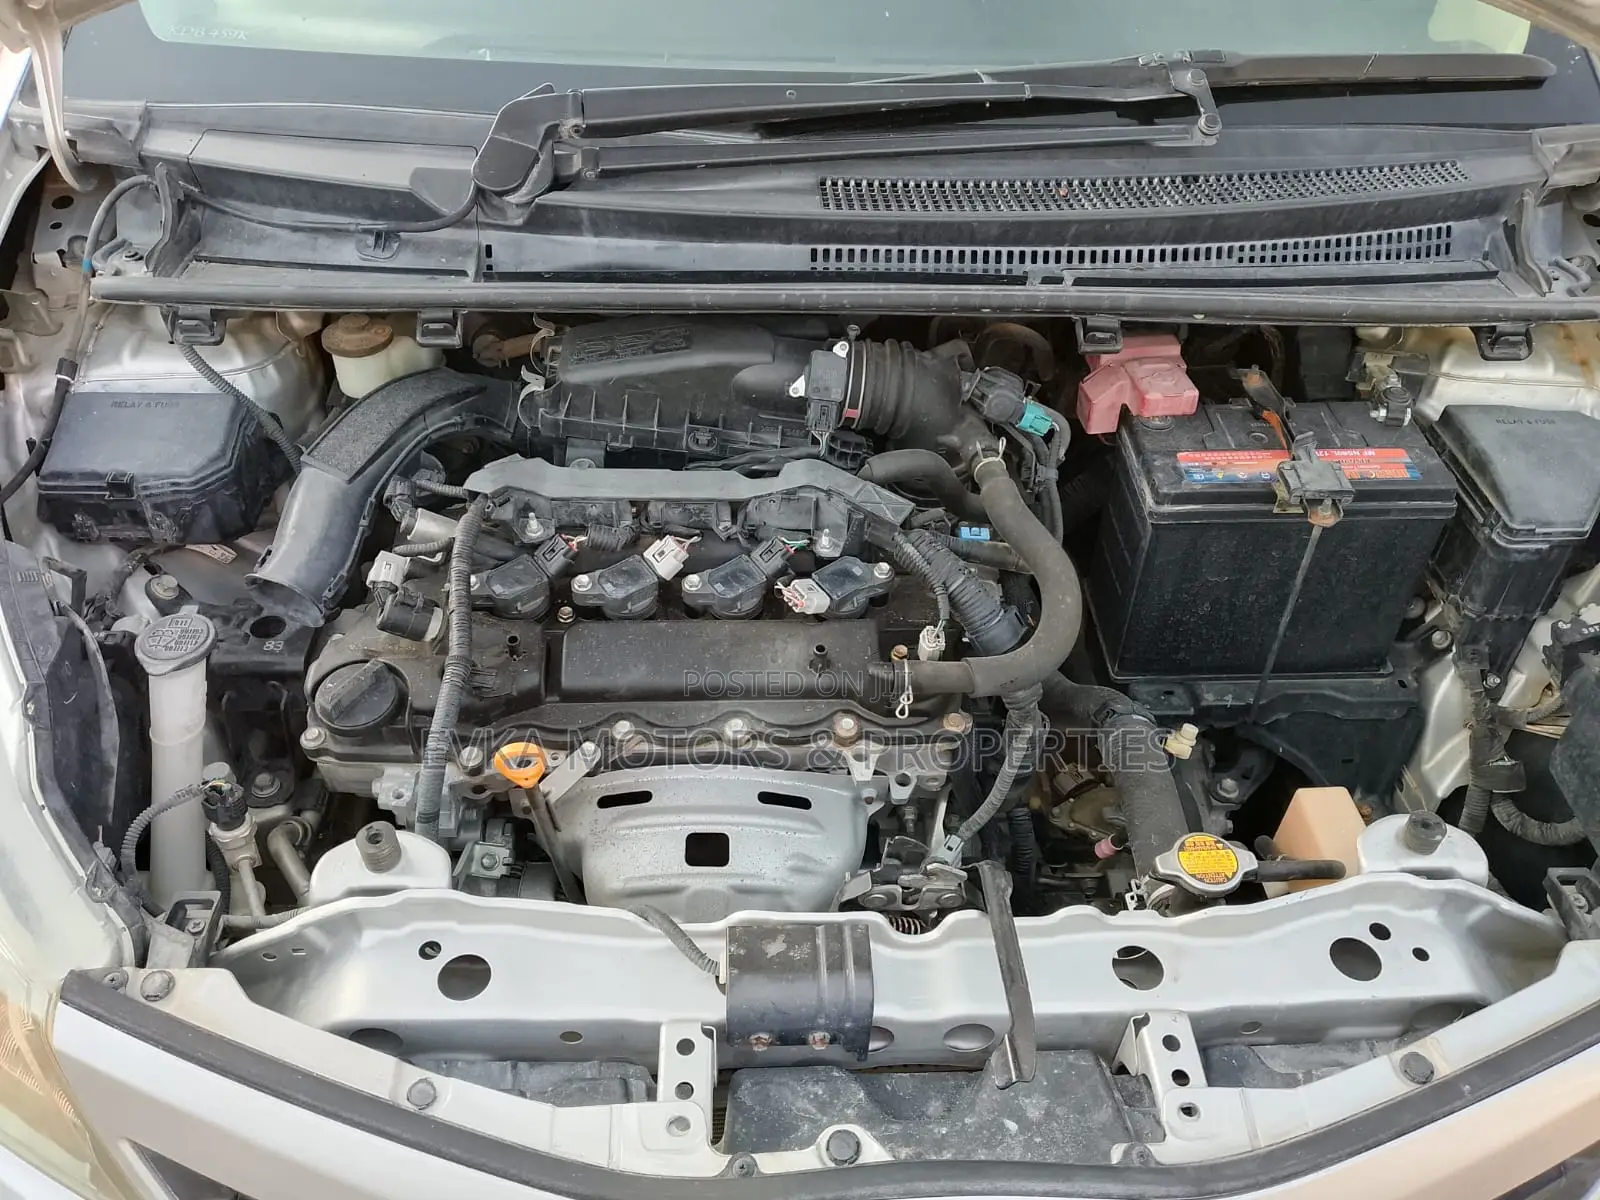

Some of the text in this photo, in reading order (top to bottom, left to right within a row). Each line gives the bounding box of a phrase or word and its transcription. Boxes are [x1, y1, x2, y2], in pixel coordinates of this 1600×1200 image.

[110, 399, 143, 409] RELAY
[1495, 417, 1523, 425] RELAY
[263, 640, 285, 651] 83
[1203, 877, 1228, 885] CAUTION
